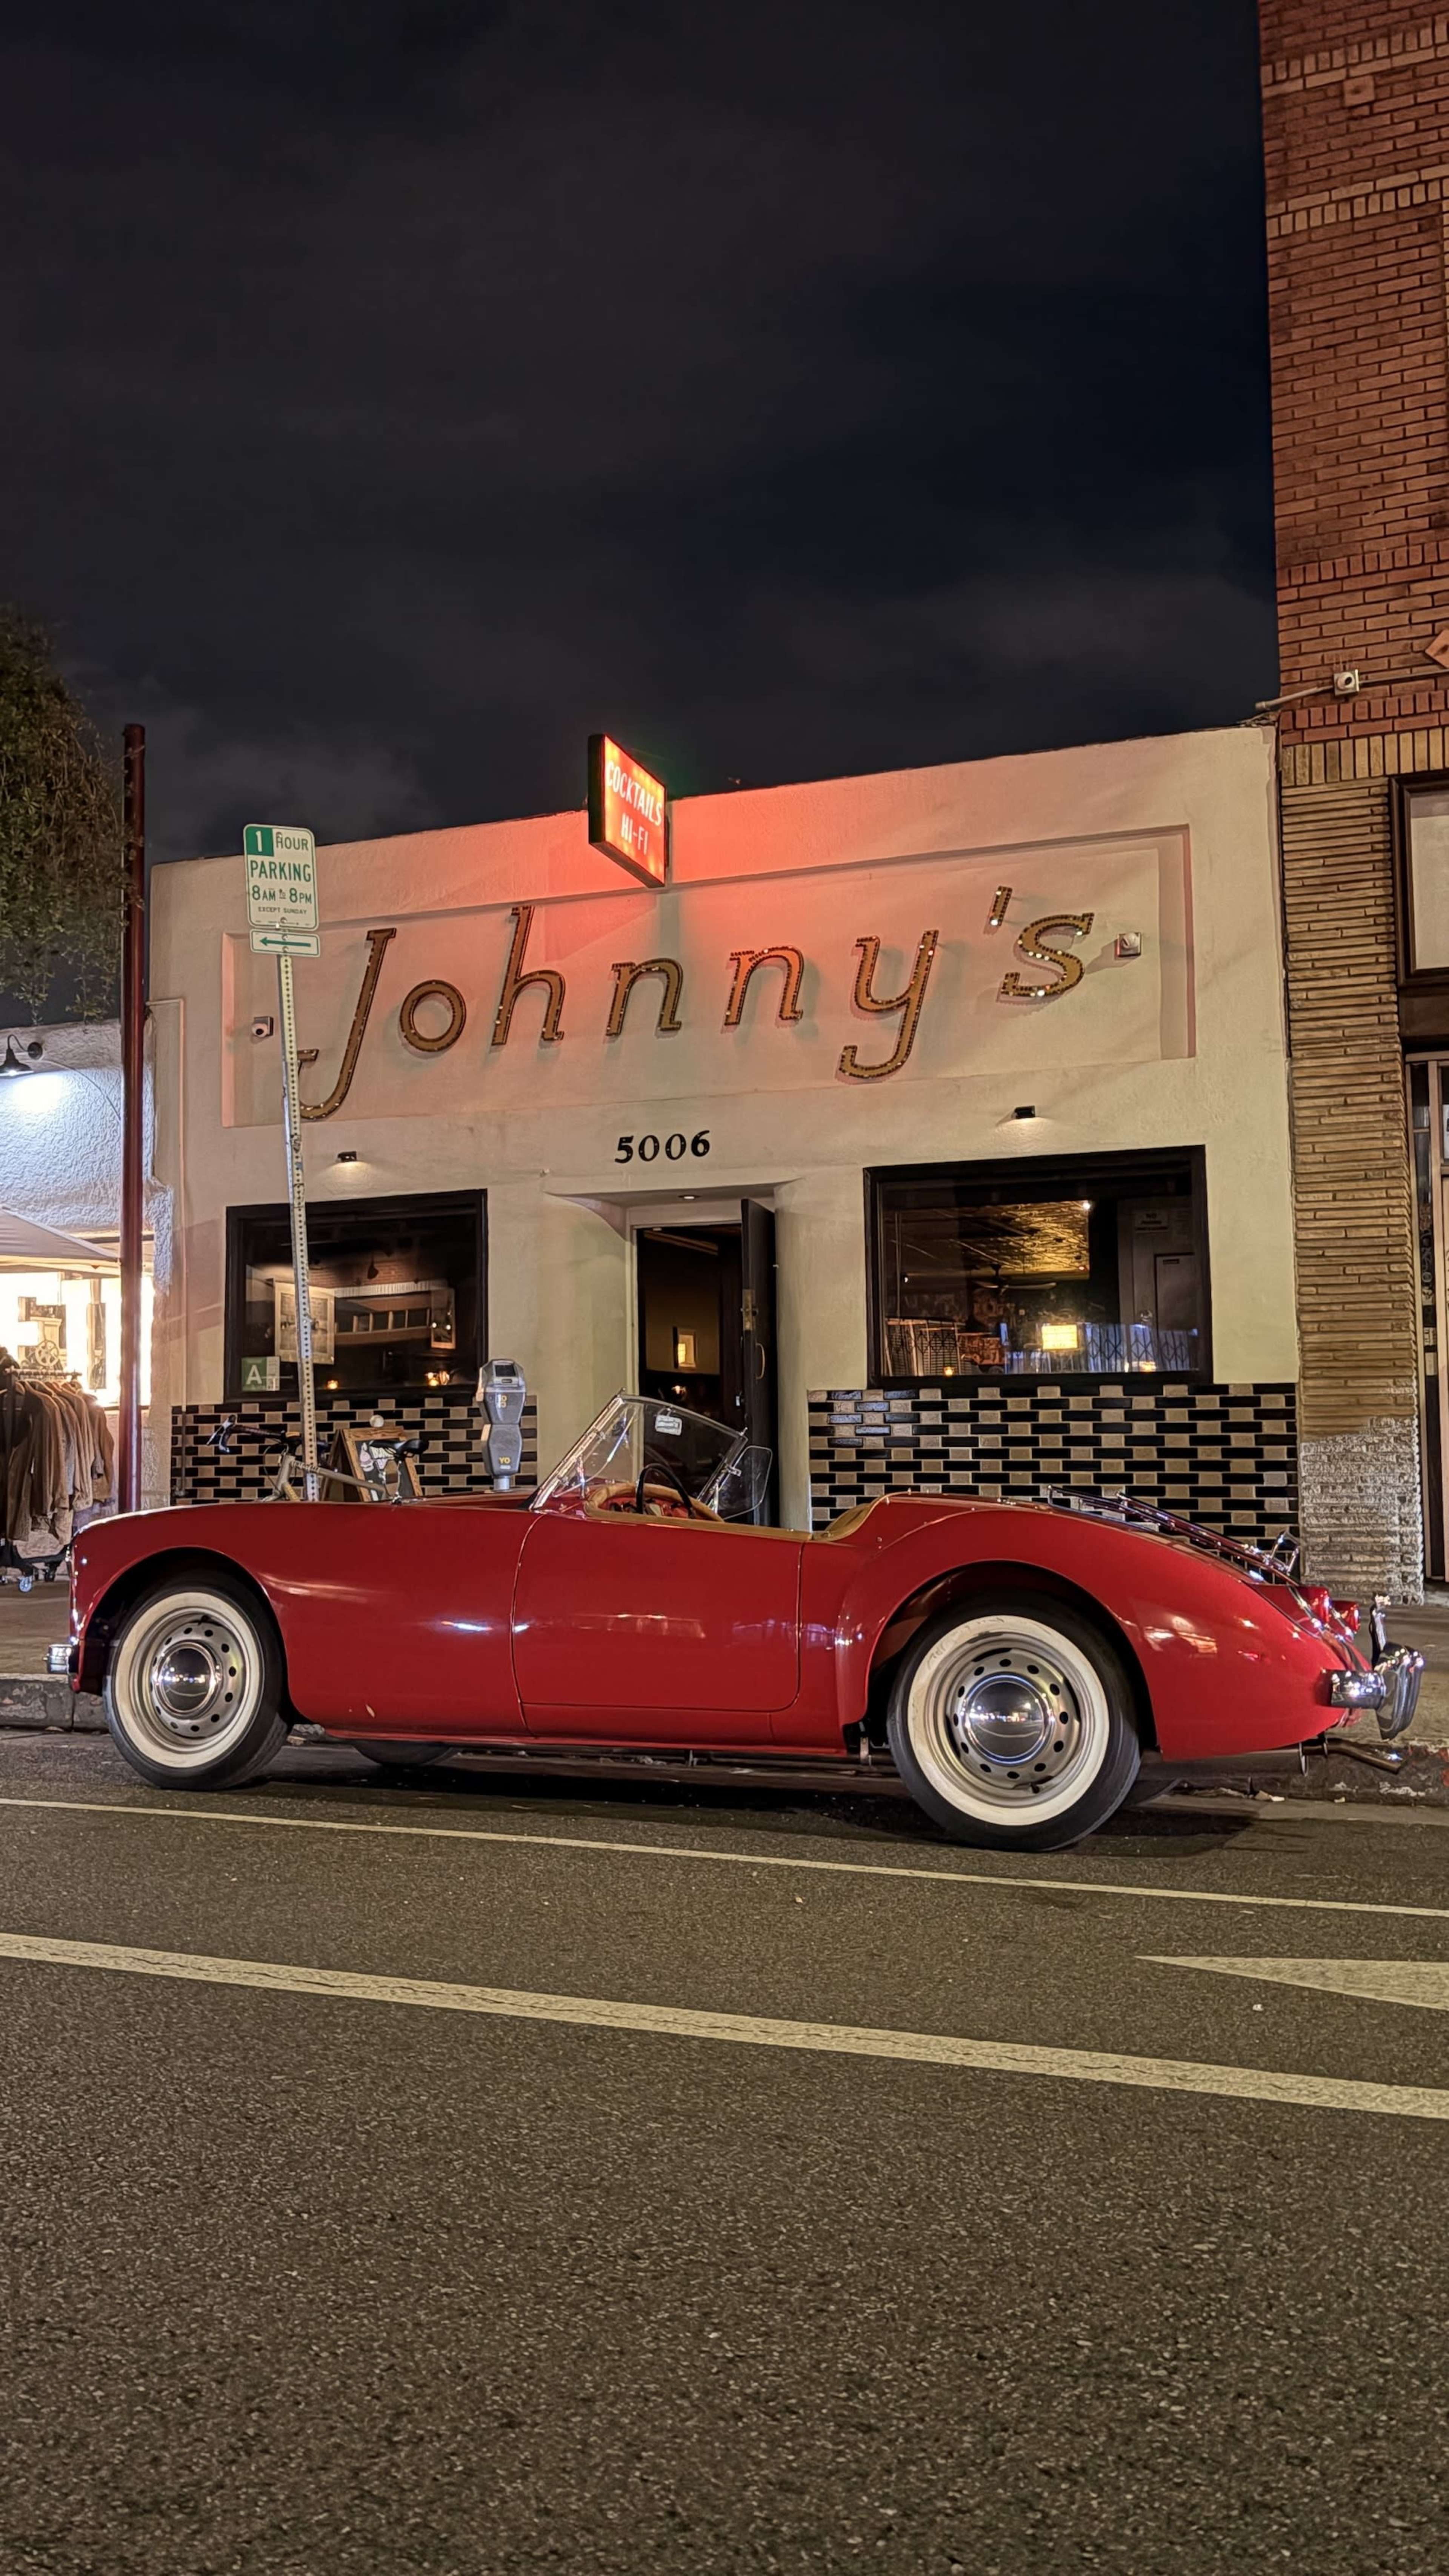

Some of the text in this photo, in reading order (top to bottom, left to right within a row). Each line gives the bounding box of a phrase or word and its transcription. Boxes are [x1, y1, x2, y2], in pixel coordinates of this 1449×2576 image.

[605, 760, 663, 826] COCKTAILS
[255, 830, 309, 852] 1 HOUR
[621, 812, 649, 856] HI-FI
[250, 860, 311, 882] PARKING
[297, 886, 1095, 1120] Johnny's
[615, 1130, 710, 1164] 5006
[246, 1365, 263, 1385] A
